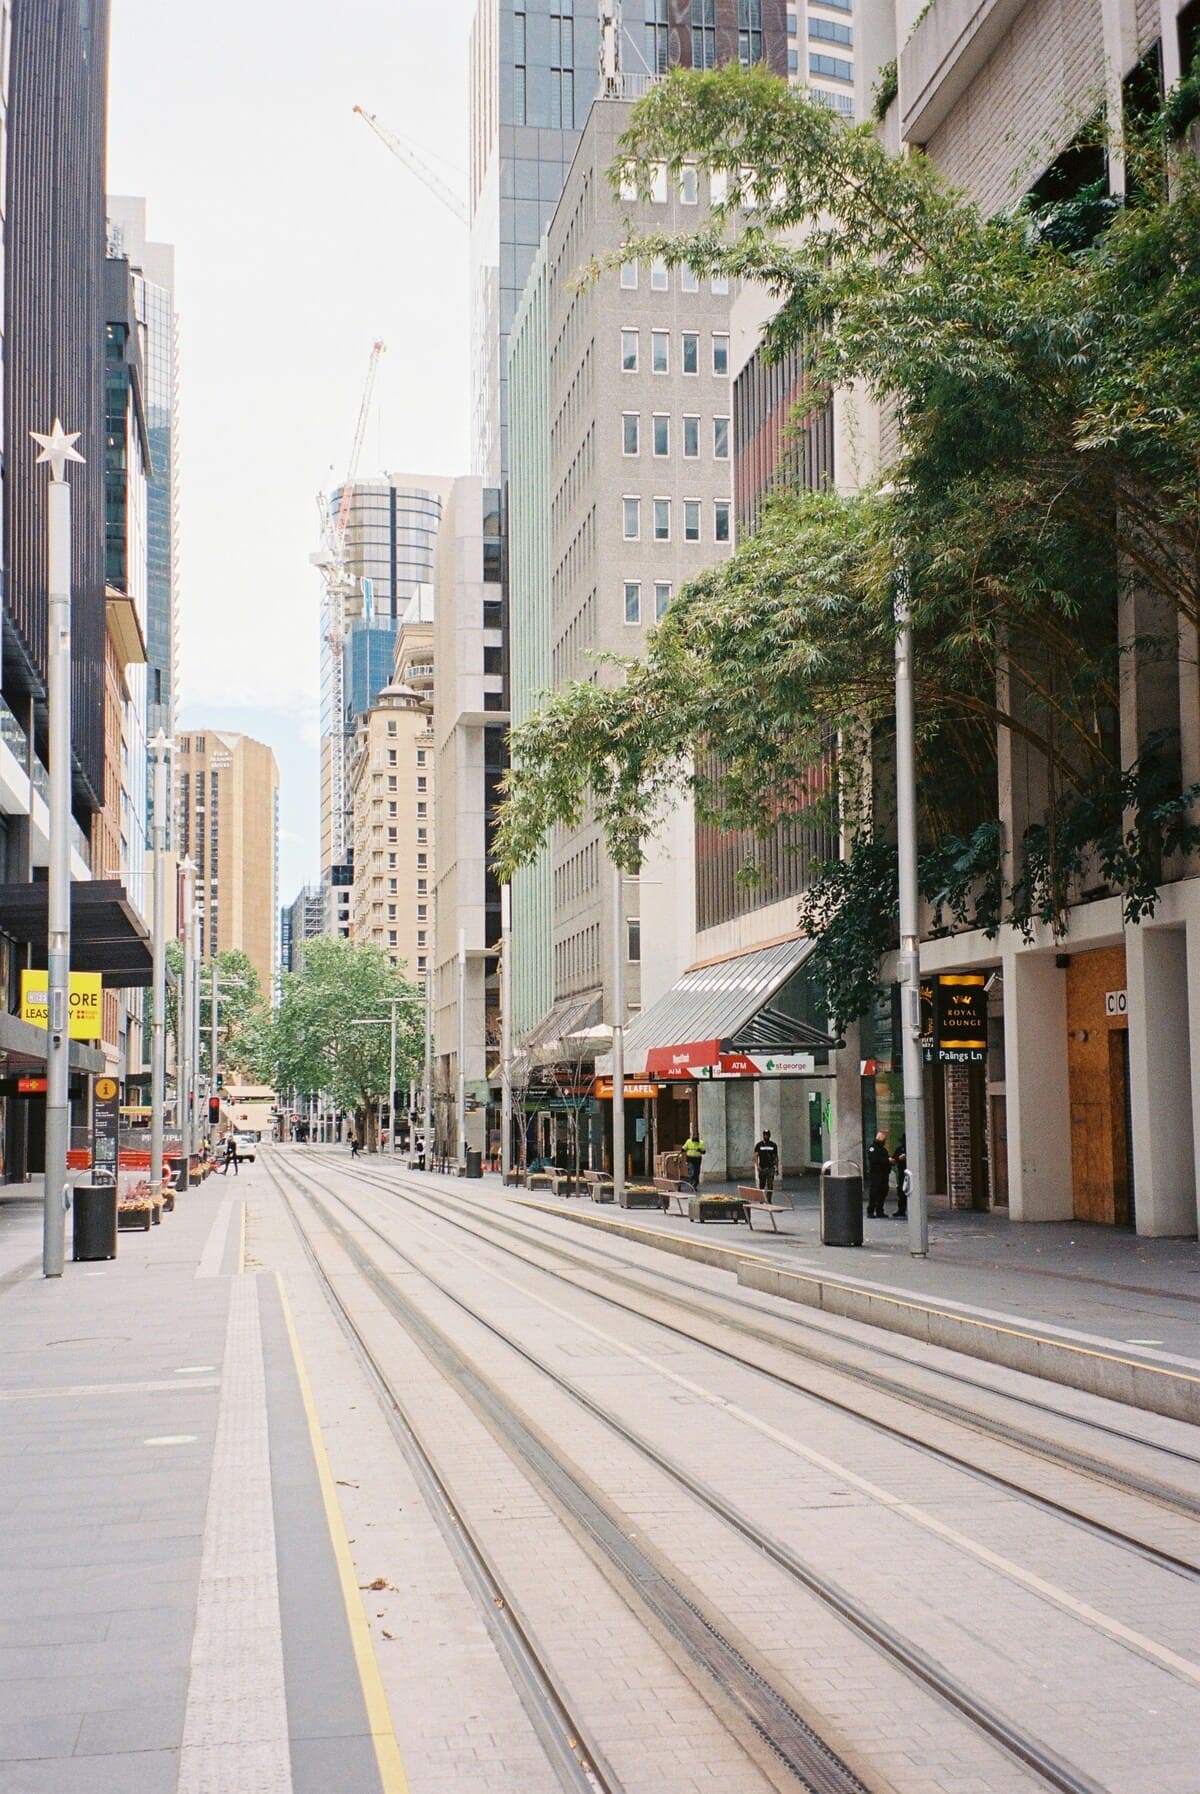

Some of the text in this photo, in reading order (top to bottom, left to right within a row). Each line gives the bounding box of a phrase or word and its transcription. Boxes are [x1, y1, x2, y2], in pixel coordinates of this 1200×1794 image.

[939, 1050, 982, 1062] Palings Ln
[731, 1062, 746, 1070] ATM
[624, 1085, 653, 1093] ALAFEL
